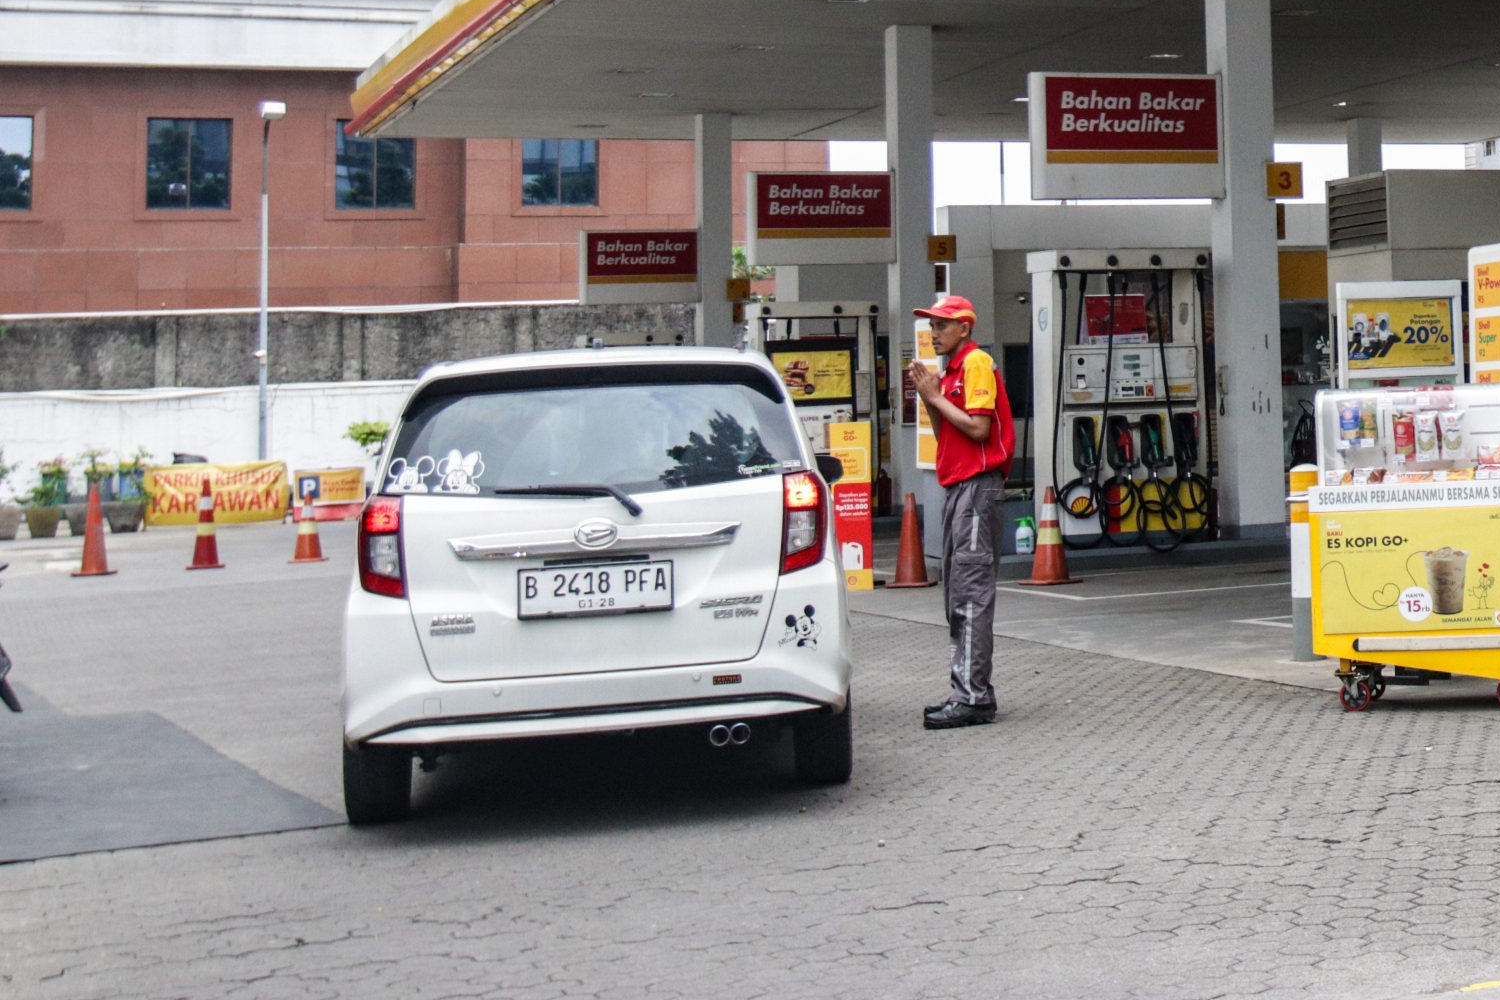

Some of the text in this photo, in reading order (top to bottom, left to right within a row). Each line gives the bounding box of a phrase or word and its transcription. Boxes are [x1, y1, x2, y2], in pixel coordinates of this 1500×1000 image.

[1061, 89, 1205, 111] Bahan Bakar
[1061, 112, 1185, 133] Berkualitas
[1278, 171, 1293, 190] 3
[769, 183, 881, 199] Bahan Bakar
[769, 200, 865, 216] Berkualitas
[597, 239, 690, 253] Bahan Bakar
[937, 242, 949, 256] 5
[597, 253, 677, 266] Berkualitas
[1403, 326, 1449, 345] 20%
[1478, 332, 1497, 346] Super
[215, 464, 281, 487] KHUSUS
[152, 489, 281, 514] KARAWAN
[1318, 491, 1368, 506] SEGARKAN
[1370, 488, 1445, 503] PERJALANANMU
[1447, 486, 1490, 500] BERSAMA
[1327, 535, 1409, 549] ES KOPI GO+
[525, 567, 667, 600] B 2418 PFA
